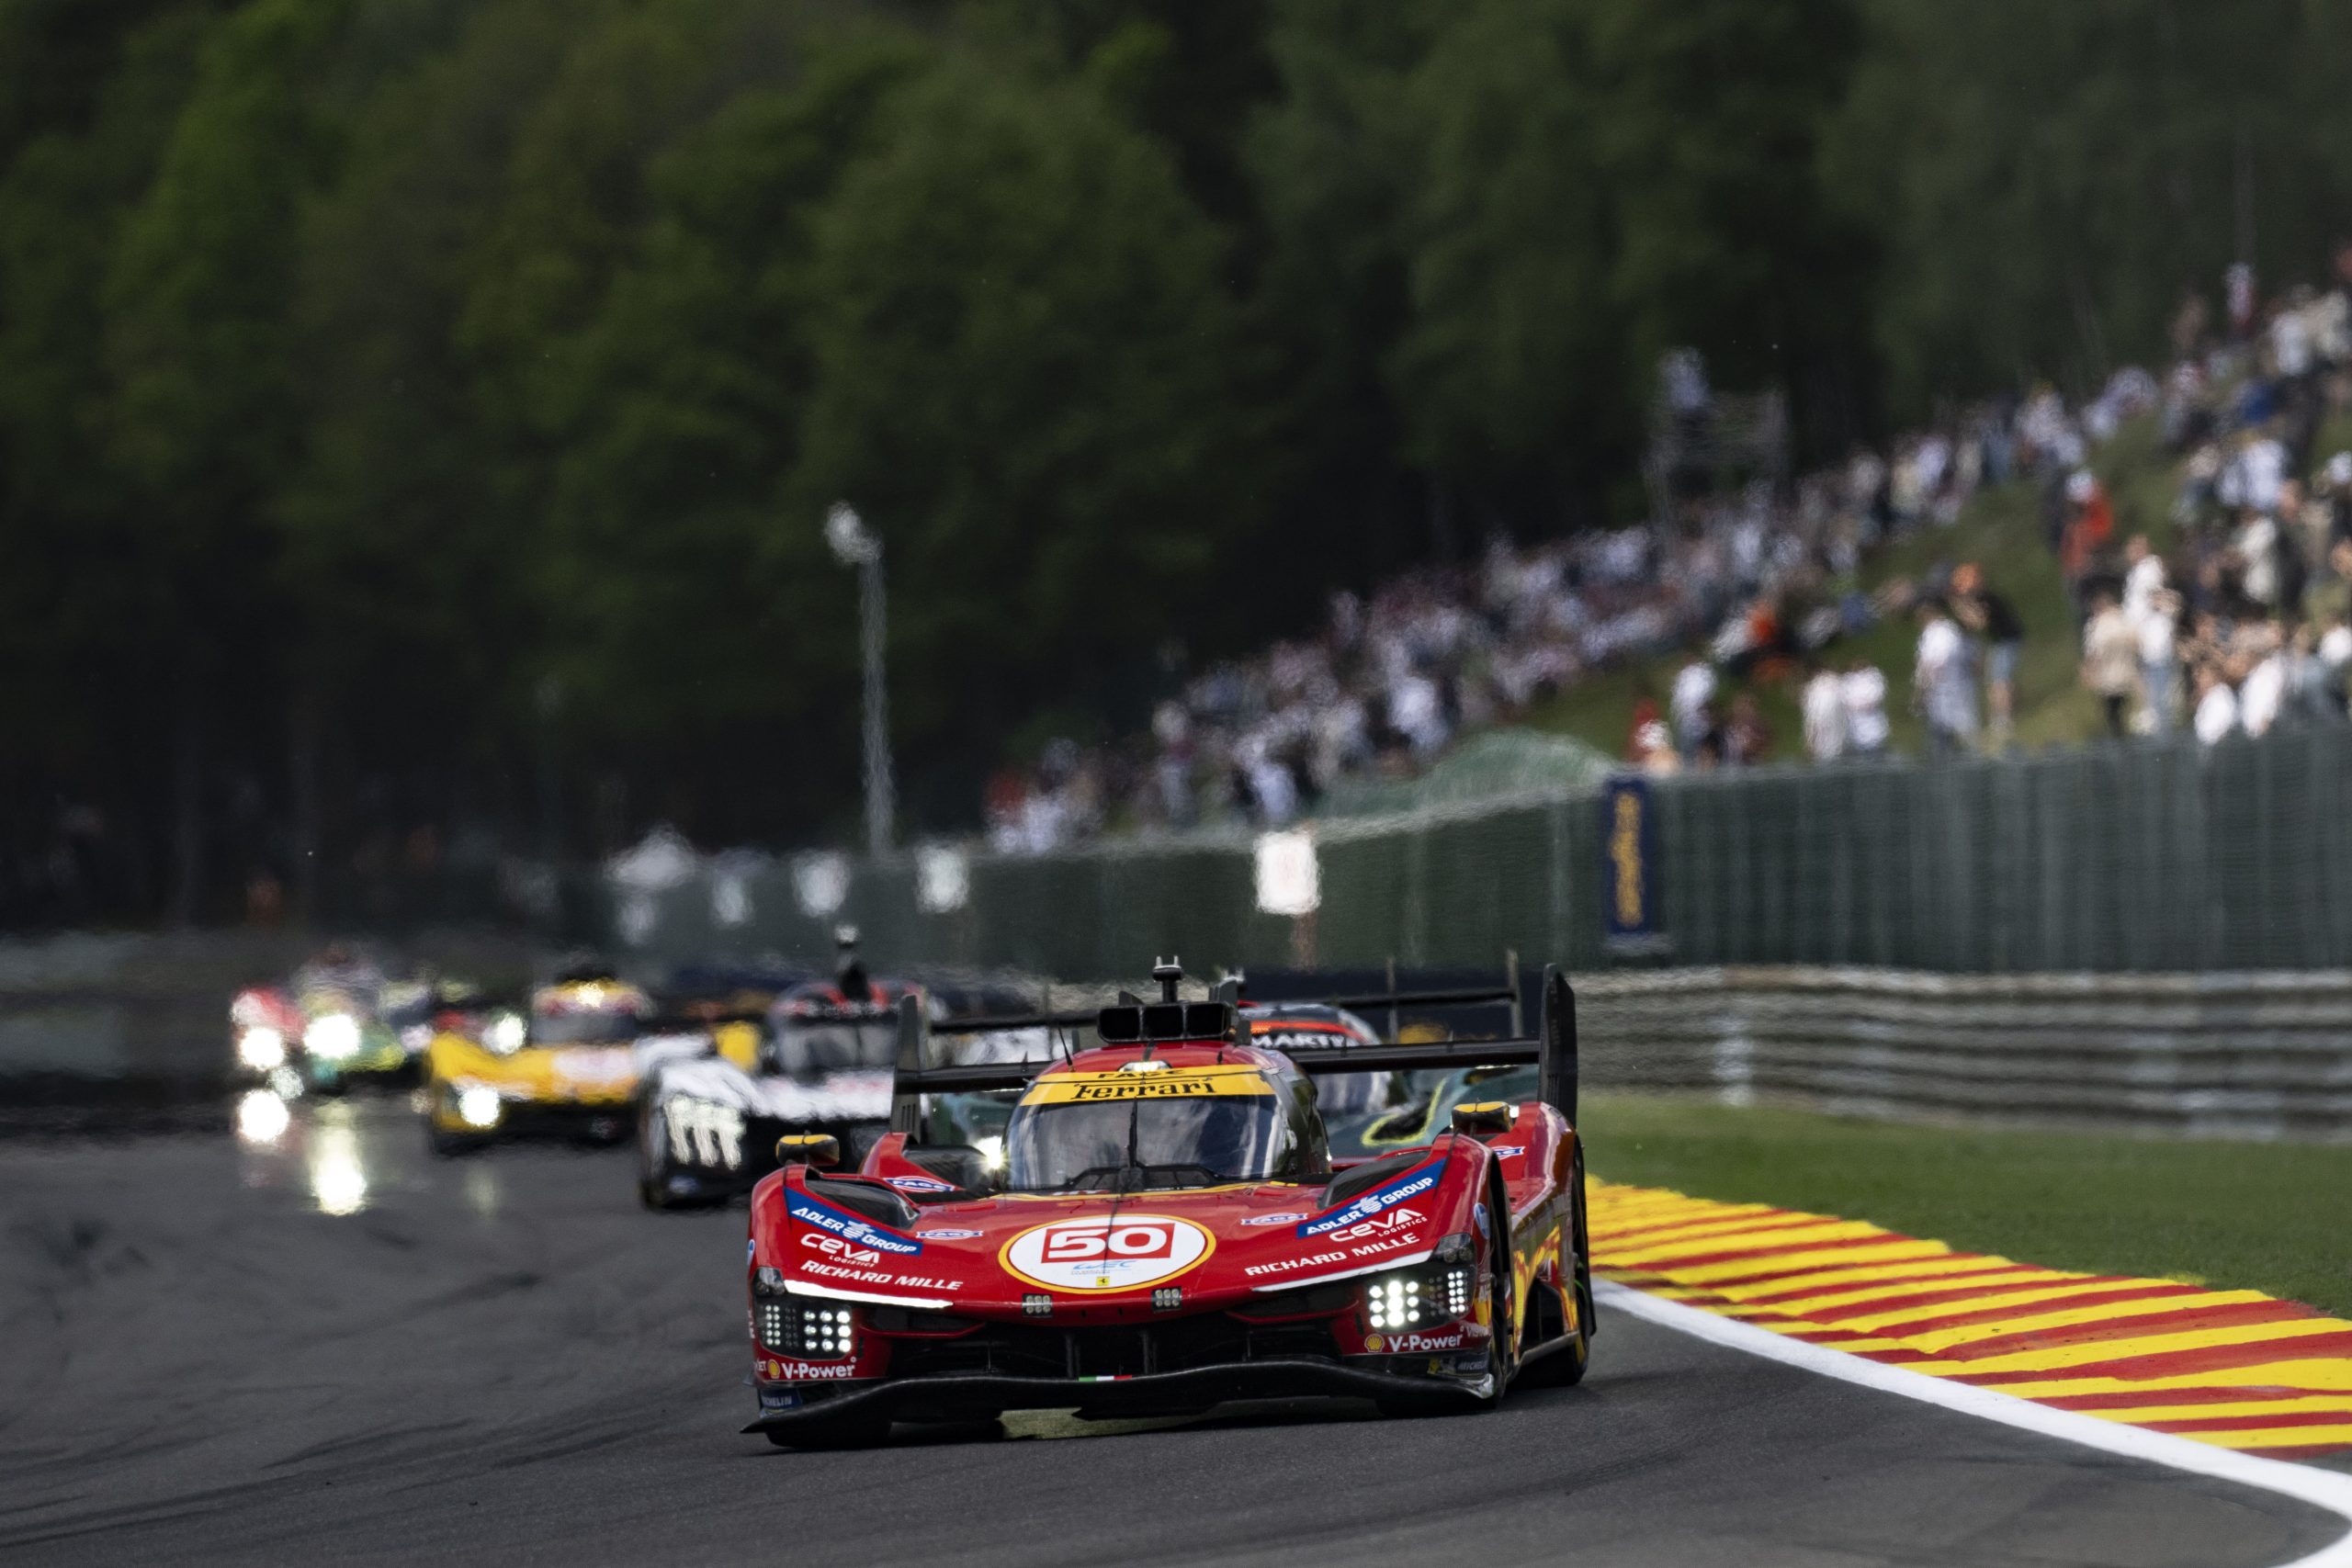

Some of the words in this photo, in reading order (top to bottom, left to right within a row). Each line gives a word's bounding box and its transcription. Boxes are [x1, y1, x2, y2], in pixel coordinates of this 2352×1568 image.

[1070, 1077, 1216, 1100] Ferrari
[1306, 1210, 1364, 1236] ADLER
[1380, 1177, 1433, 1204] GROUP
[791, 1206, 845, 1232] ADLER
[861, 1234, 918, 1253] GROUP
[1377, 1216, 1428, 1238] LOGISTICS
[1047, 1226, 1167, 1259] 50
[1244, 1251, 1347, 1277] RICHARD
[1351, 1232, 1420, 1257] MILLE
[800, 1259, 893, 1284] RICHARD
[895, 1275, 964, 1291] MILLE
[829, 1255, 876, 1268] LOGISTICS
[1388, 1334, 1463, 1353] V-Power
[781, 1362, 856, 1379] V-Power
